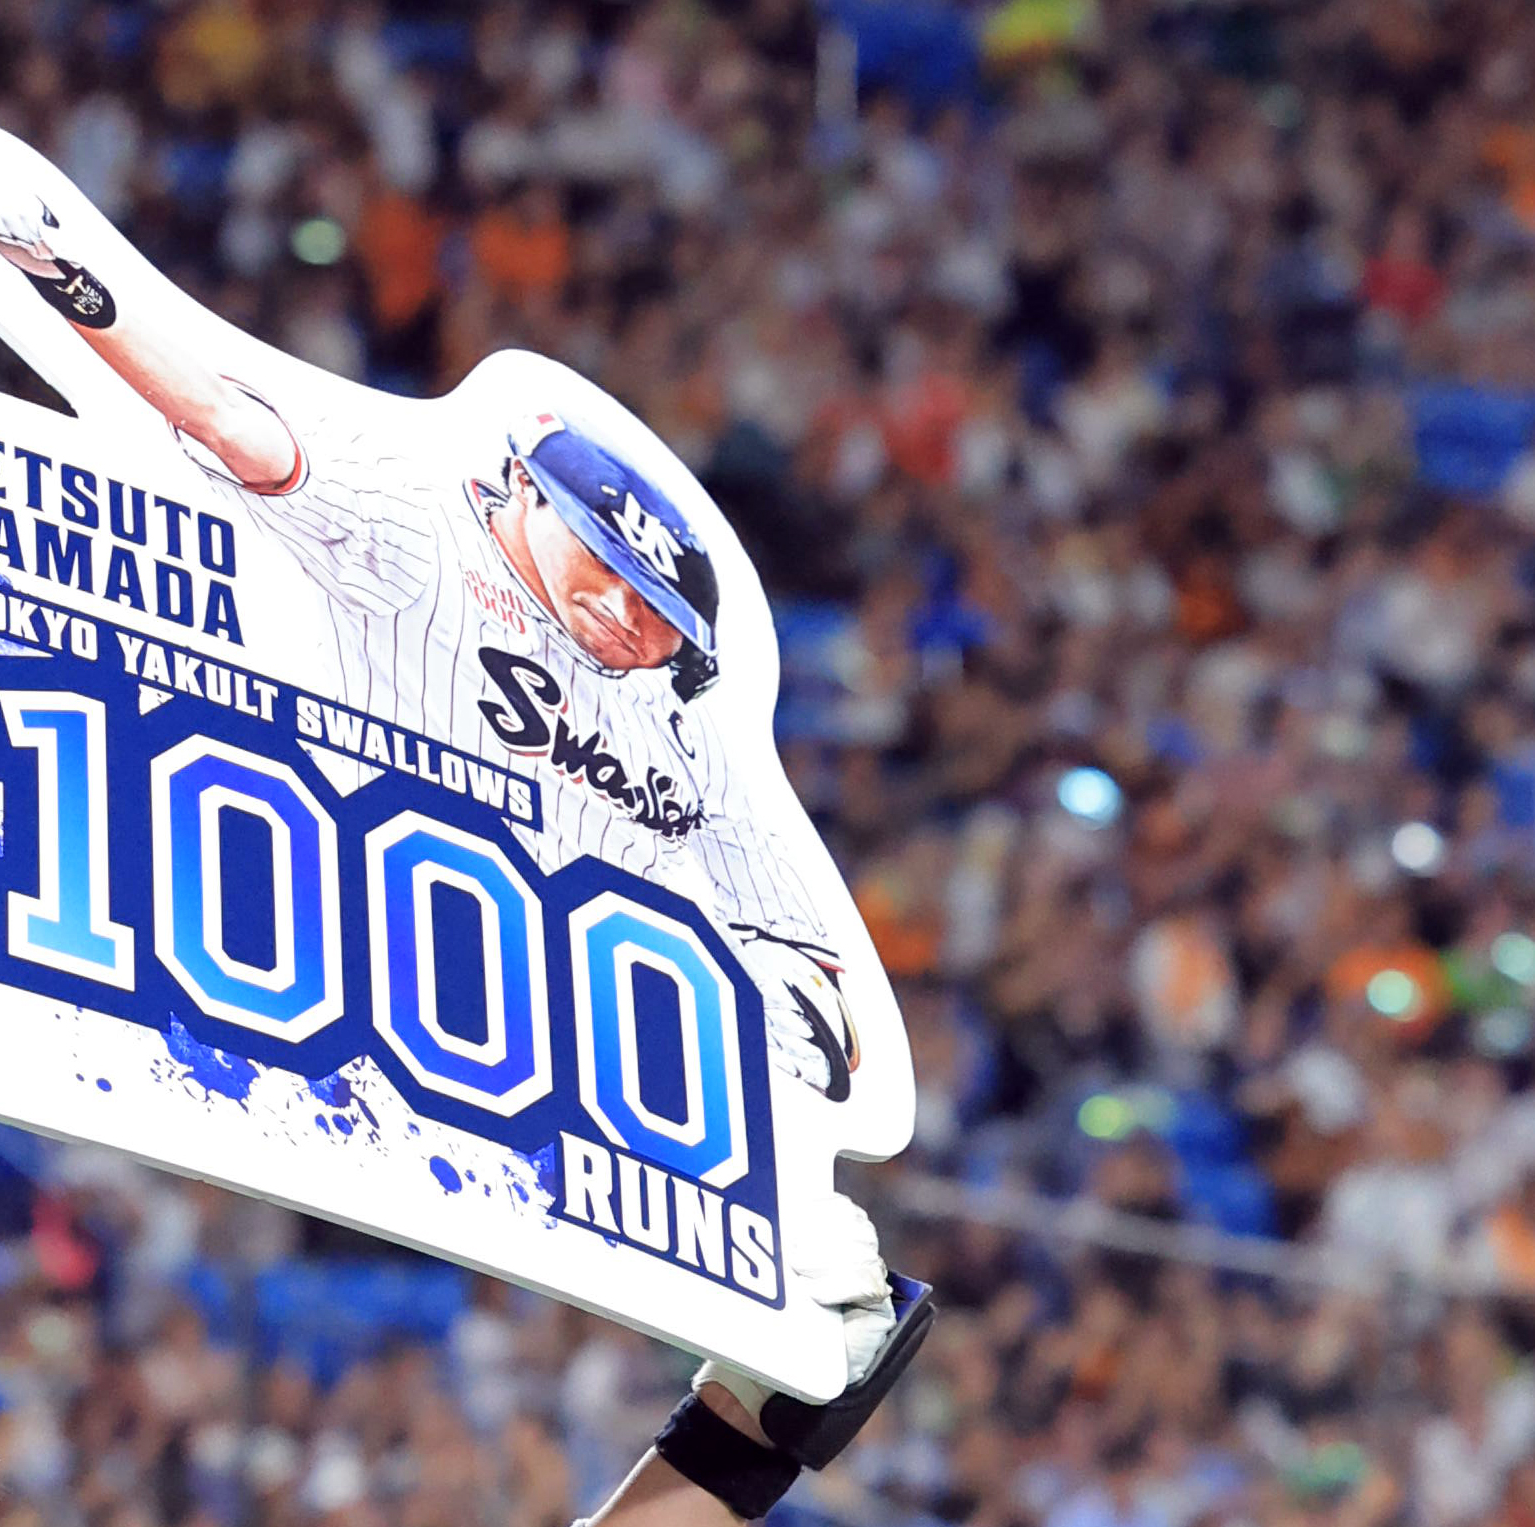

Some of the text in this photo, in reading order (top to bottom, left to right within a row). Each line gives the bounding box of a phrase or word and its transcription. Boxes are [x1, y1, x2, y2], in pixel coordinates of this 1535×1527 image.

[116, 631, 279, 723] YAKULT
[295, 694, 534, 822] SWALLOWS
[477, 646, 702, 839] Swallo
[560, 1131, 780, 1301] RUNS
